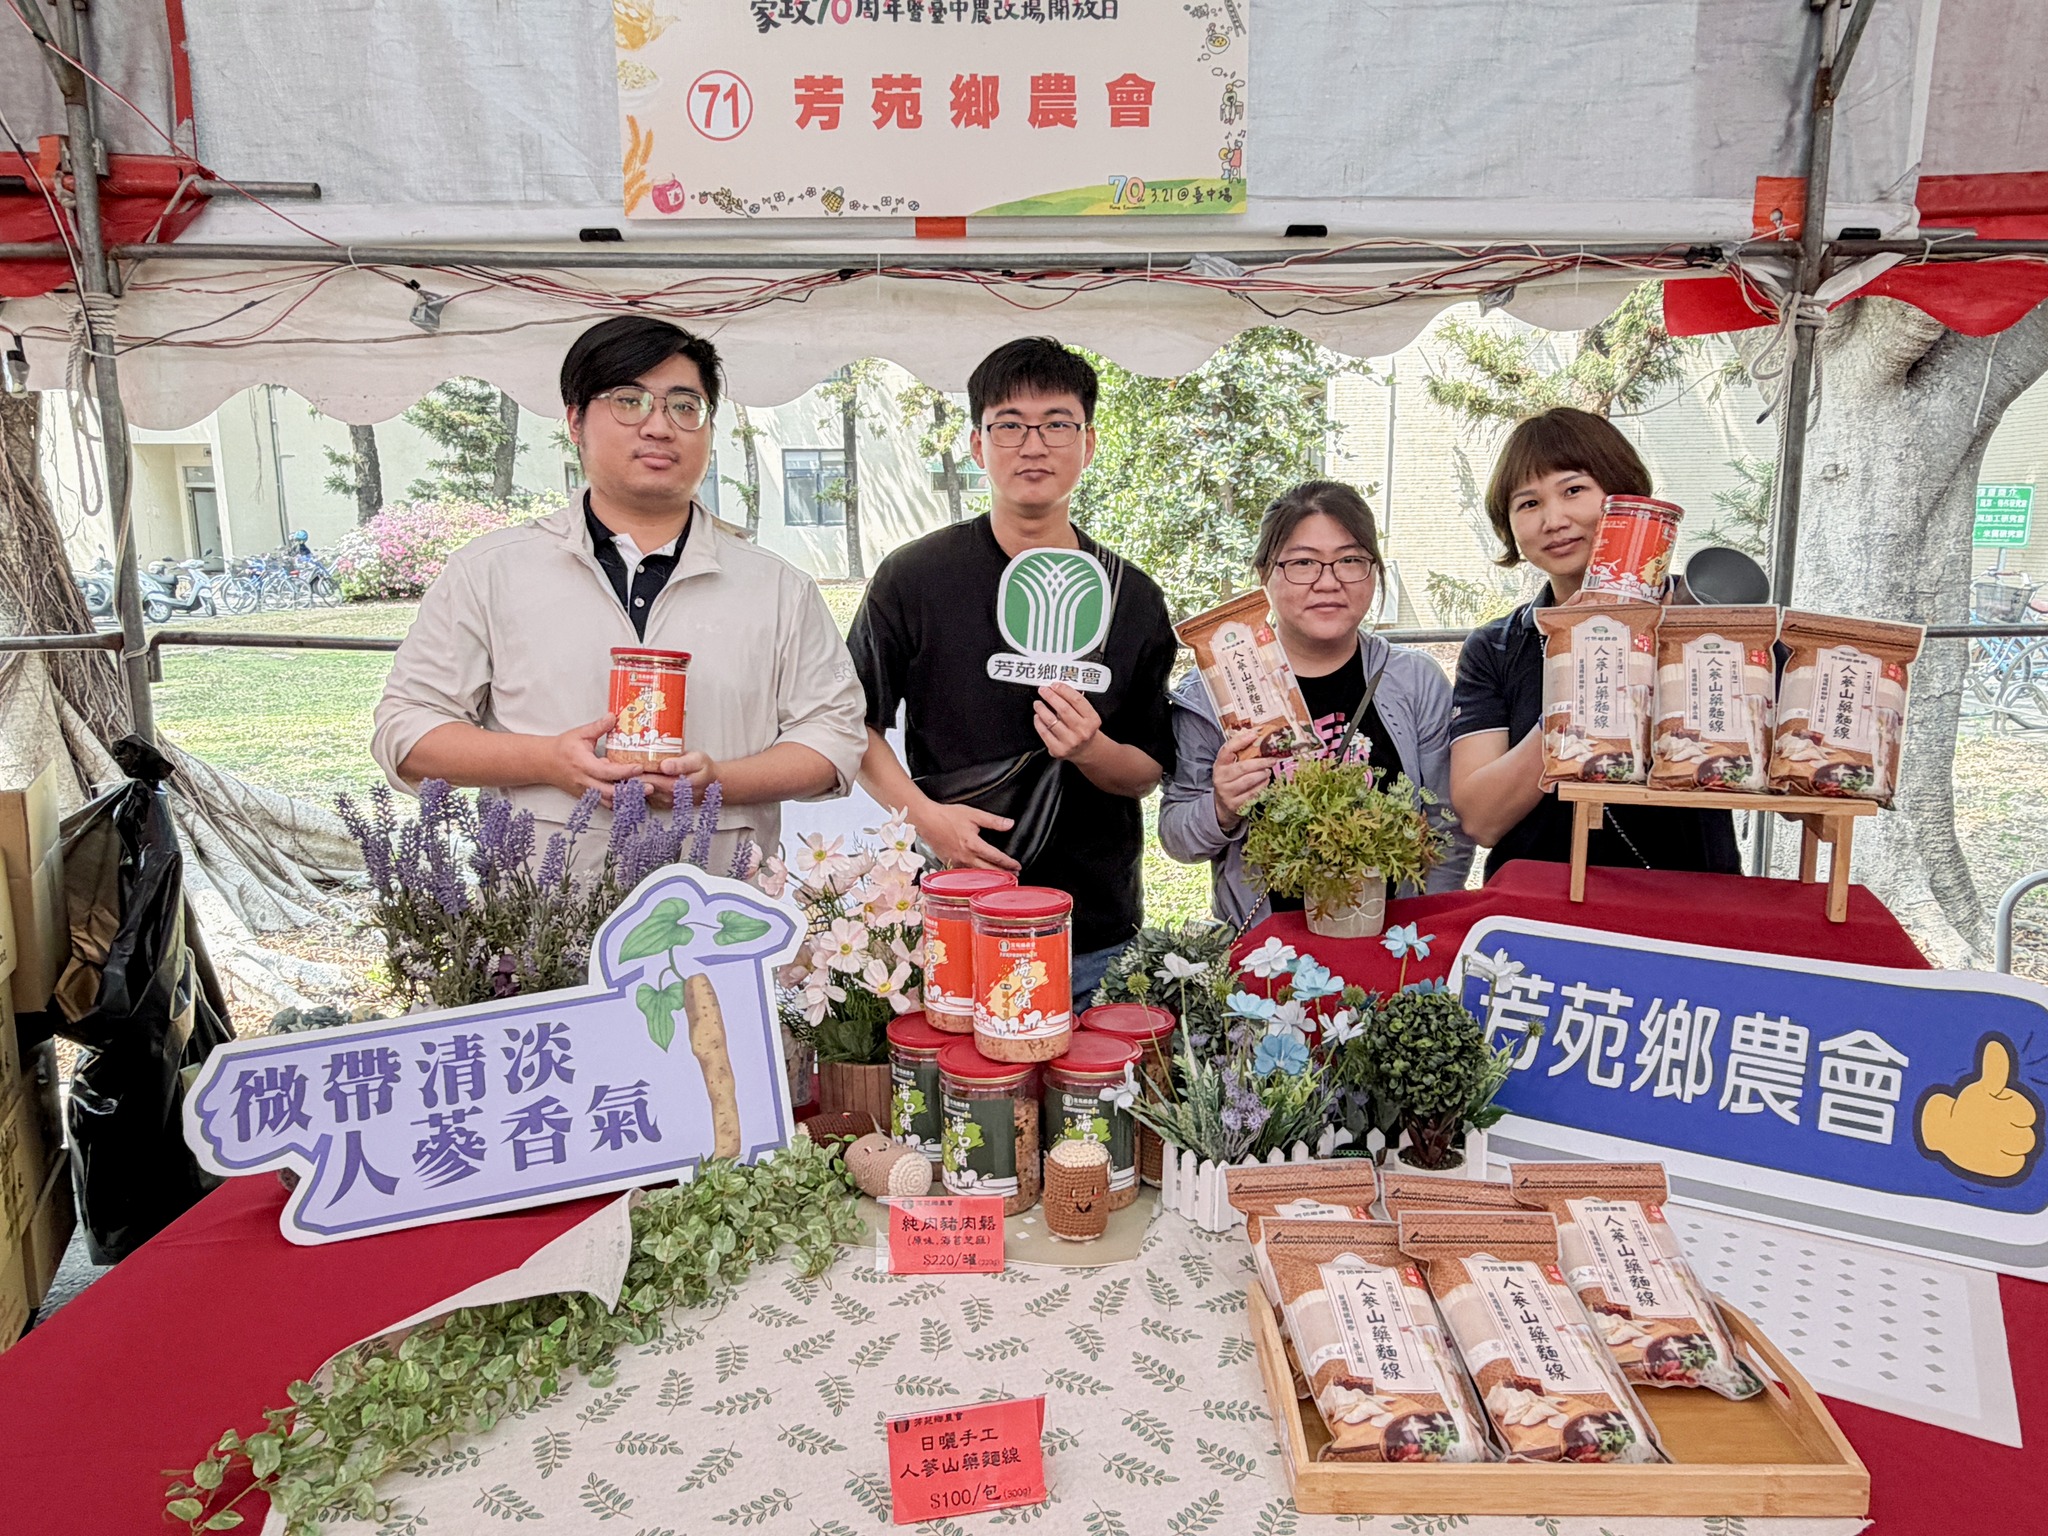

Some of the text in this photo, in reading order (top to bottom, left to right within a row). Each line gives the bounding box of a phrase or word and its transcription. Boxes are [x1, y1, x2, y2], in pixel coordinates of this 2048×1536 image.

[697, 84, 741, 129] 71
[793, 73, 1156, 130] 芳苑鄉農會
[993, 659, 1103, 685] 芳苑鄉農會
[230, 1022, 576, 1142] 微帶清淡
[1480, 974, 1910, 1146] 芳苑鄉農會
[325, 1078, 663, 1210] 人蔘香氣
[901, 1215, 997, 1232] 純肉豬肉鬆
[1604, 1215, 1661, 1307] 人蔘山藥麵線
[1356, 1279, 1405, 1381] 人蔘山藥麵線
[1502, 1276, 1572, 1382] 人蔘山藥麵線
[900, 1446, 1022, 1479] 人蔘山藥麵線
[921, 1428, 999, 1452] 日曬手工
